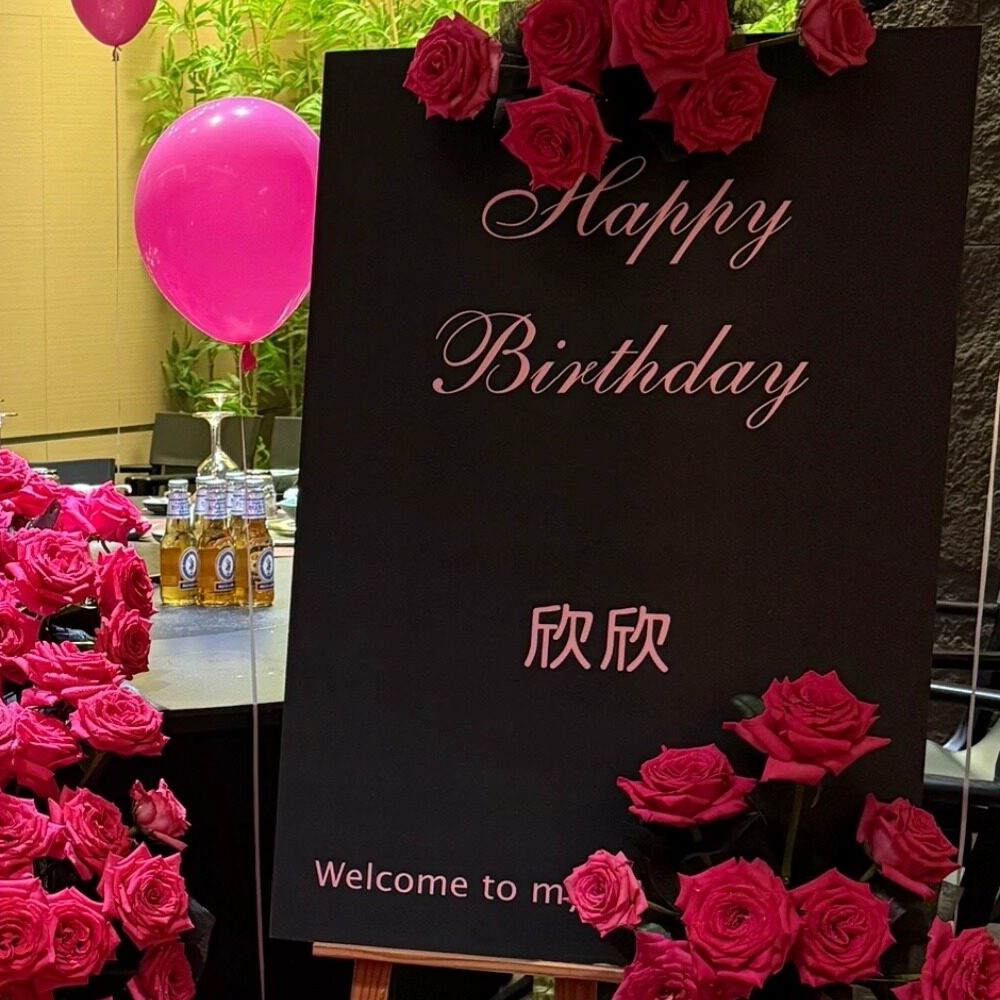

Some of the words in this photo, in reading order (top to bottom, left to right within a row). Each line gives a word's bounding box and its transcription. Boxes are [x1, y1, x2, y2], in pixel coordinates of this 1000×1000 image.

[482, 156, 793, 270] Happy
[432, 310, 809, 430] Birthday
[524, 603, 671, 673] 欣欣
[315, 860, 468, 898] Welcome
[482, 875, 517, 901] to
